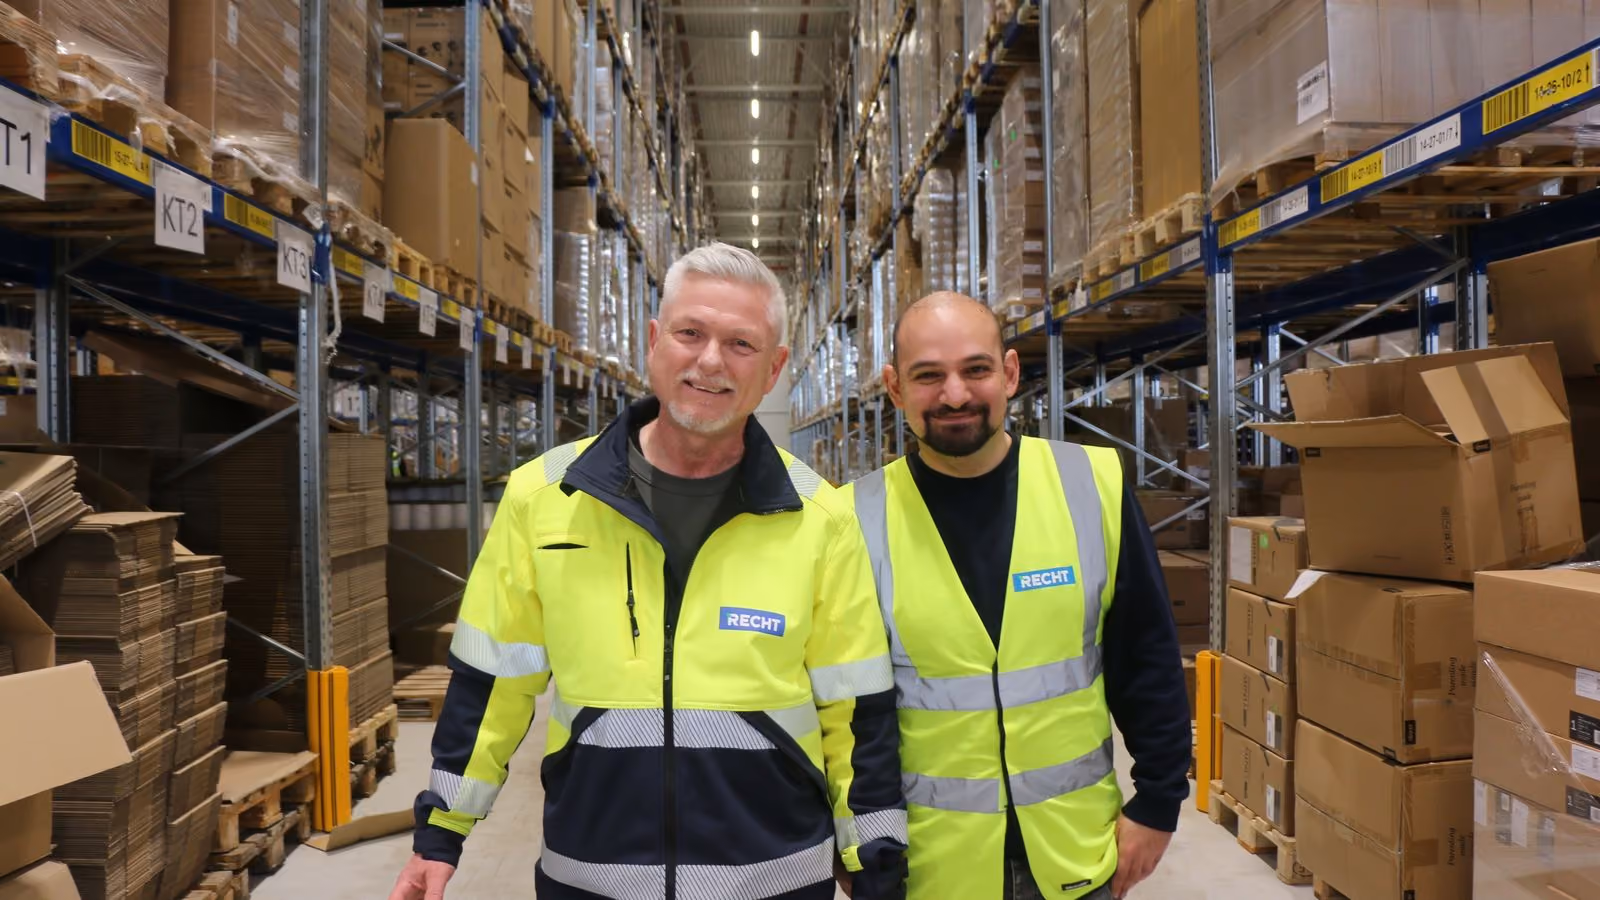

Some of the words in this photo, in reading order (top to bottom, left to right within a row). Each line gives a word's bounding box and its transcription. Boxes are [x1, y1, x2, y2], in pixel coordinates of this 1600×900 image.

[163, 193, 198, 237] KT2
[283, 243, 306, 279] KT3
[1020, 570, 1069, 588] RECHT
[727, 612, 781, 632] RECHT
